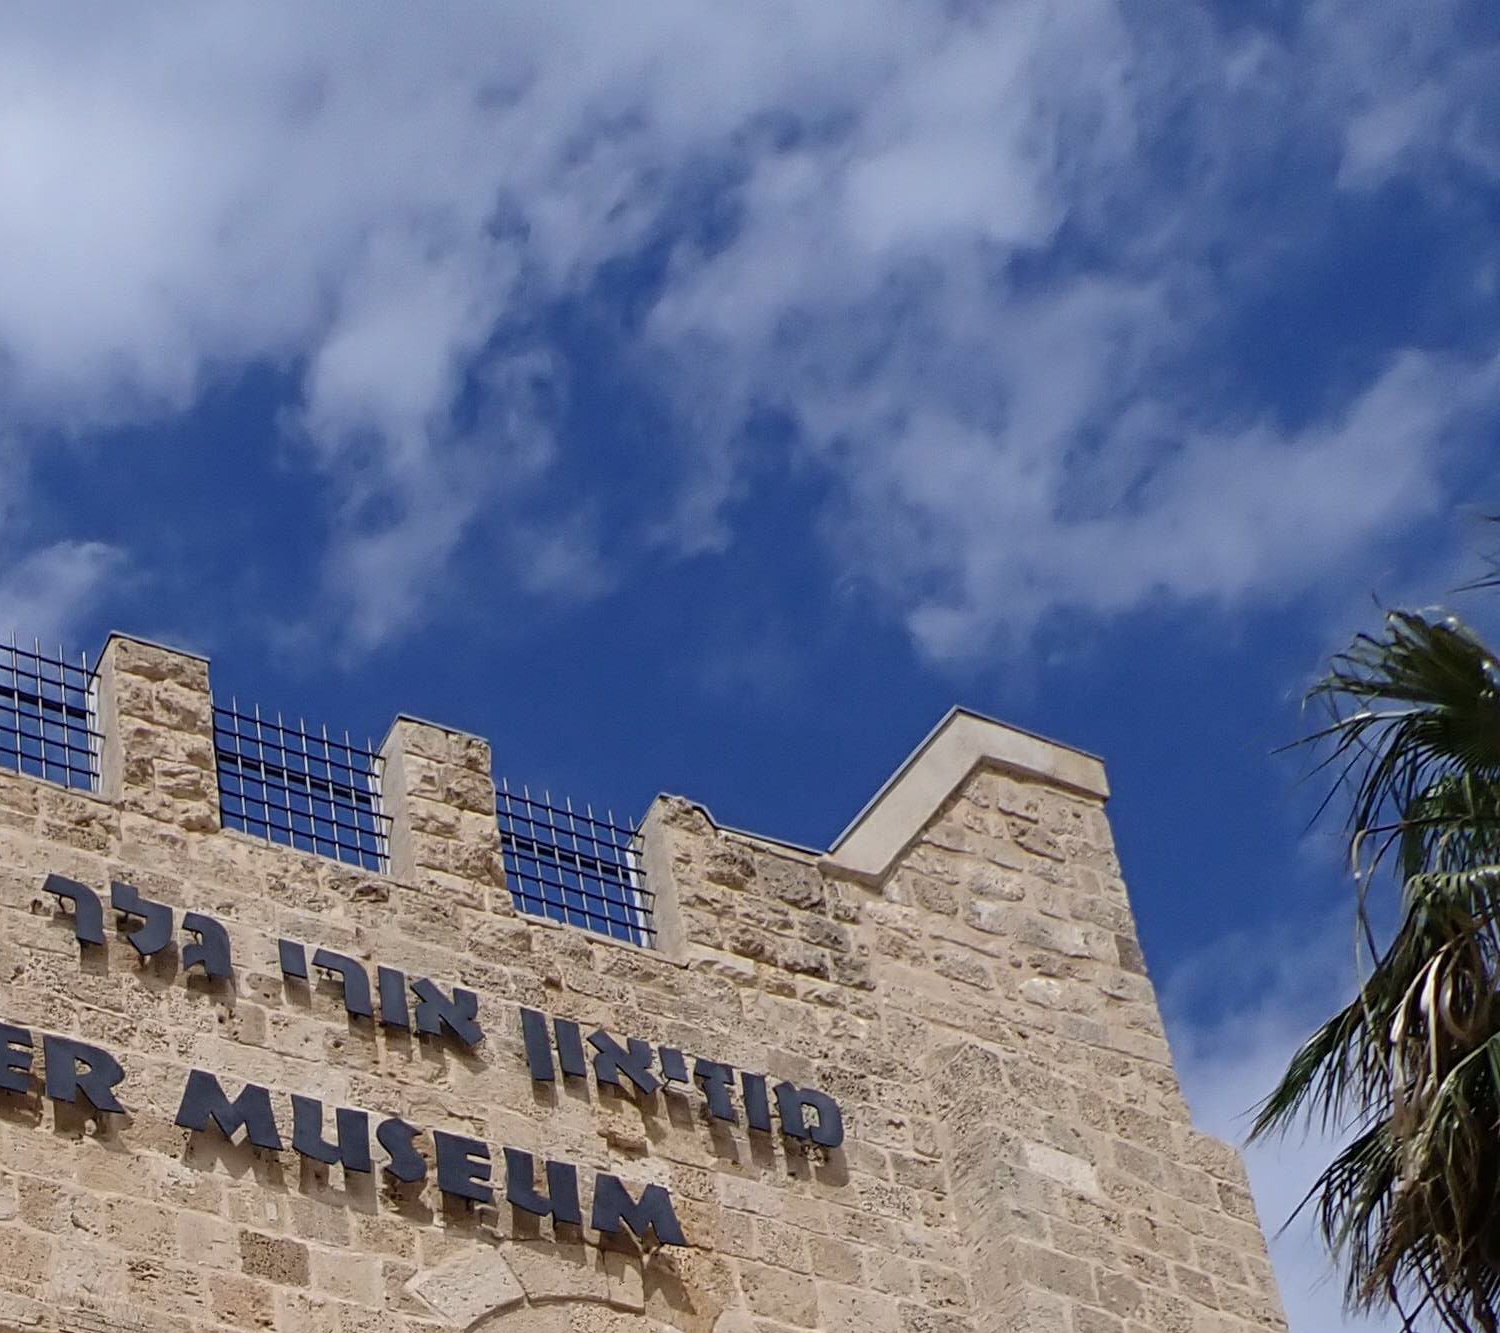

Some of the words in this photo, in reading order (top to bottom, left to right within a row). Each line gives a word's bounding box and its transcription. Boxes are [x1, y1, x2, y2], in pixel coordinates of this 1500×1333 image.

[41, 872, 232, 978] גלר
[278, 938, 485, 1047] אורי
[520, 1006, 844, 1148] מוזיאון
[174, 1068, 687, 1247] MUSEUM
